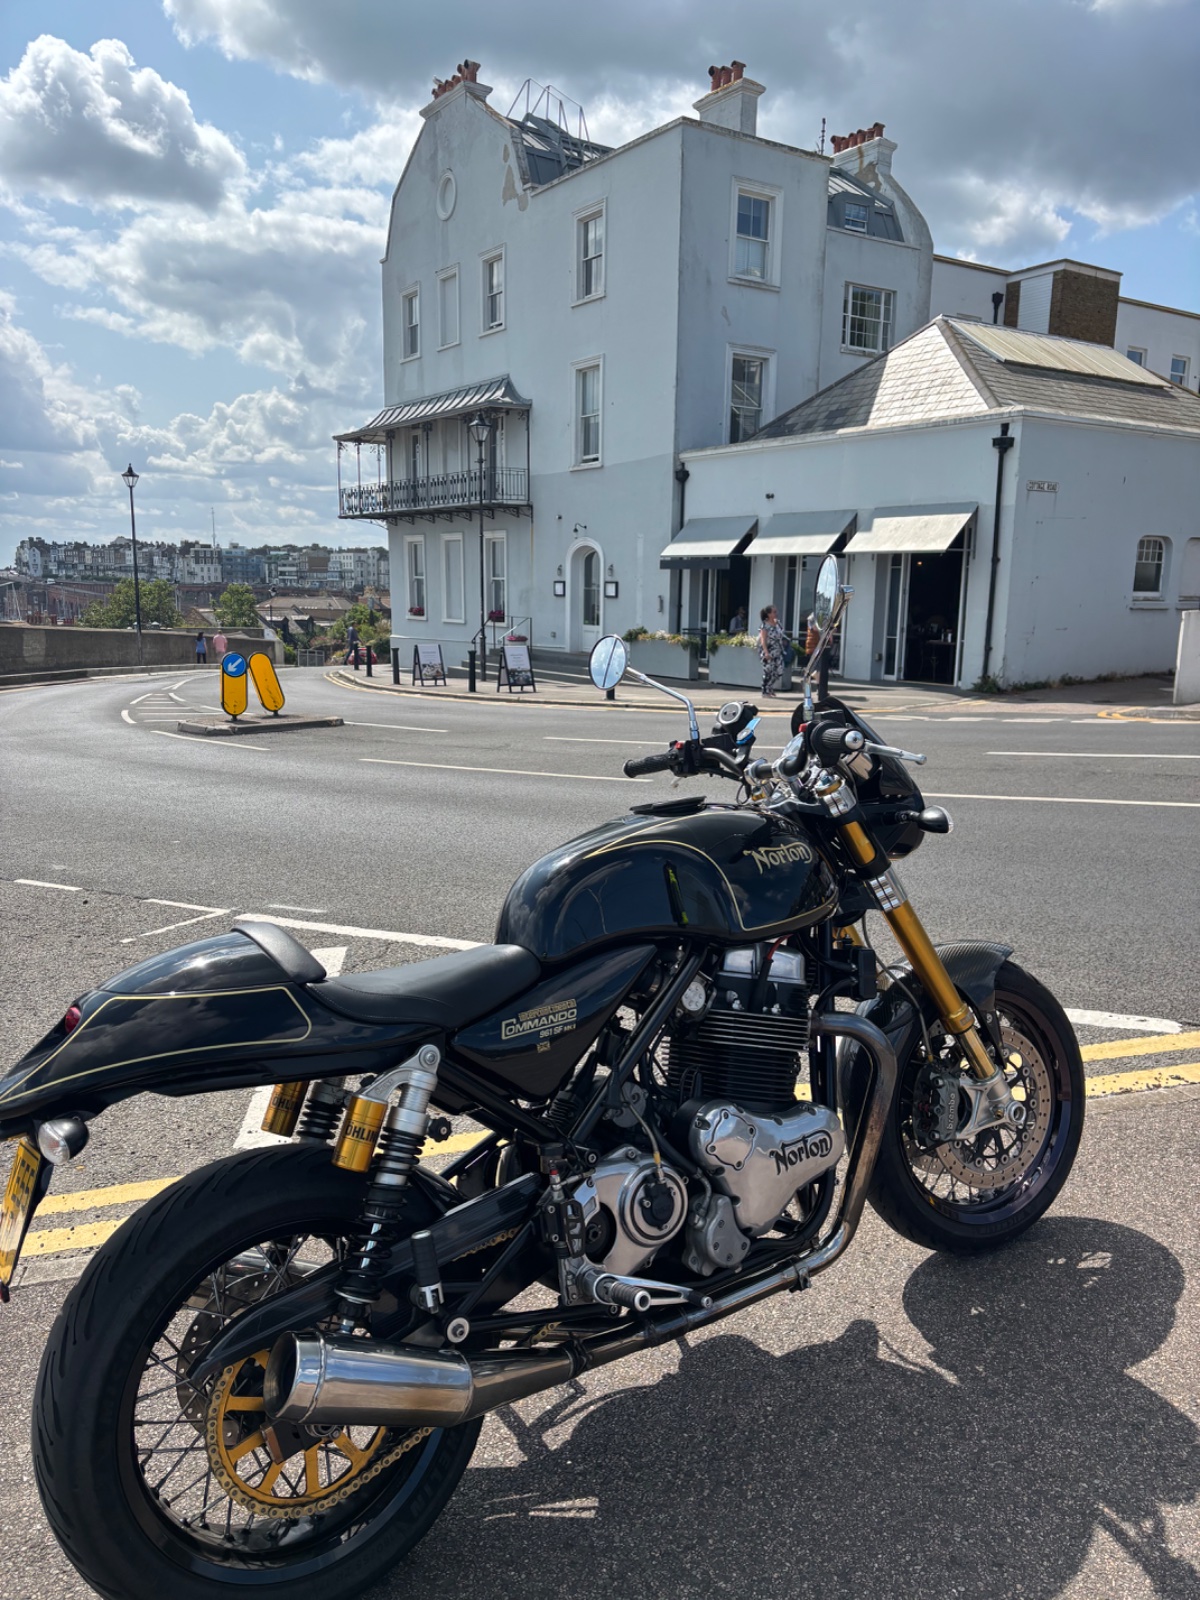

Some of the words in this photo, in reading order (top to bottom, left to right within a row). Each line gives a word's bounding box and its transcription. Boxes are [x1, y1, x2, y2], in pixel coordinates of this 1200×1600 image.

[743, 842, 812, 874] Norton
[502, 1008, 577, 1040] COMMANDO
[947, 1093, 956, 1130] brembo
[345, 1121, 377, 1143] ÖHLIN
[769, 1130, 832, 1175] Norton
